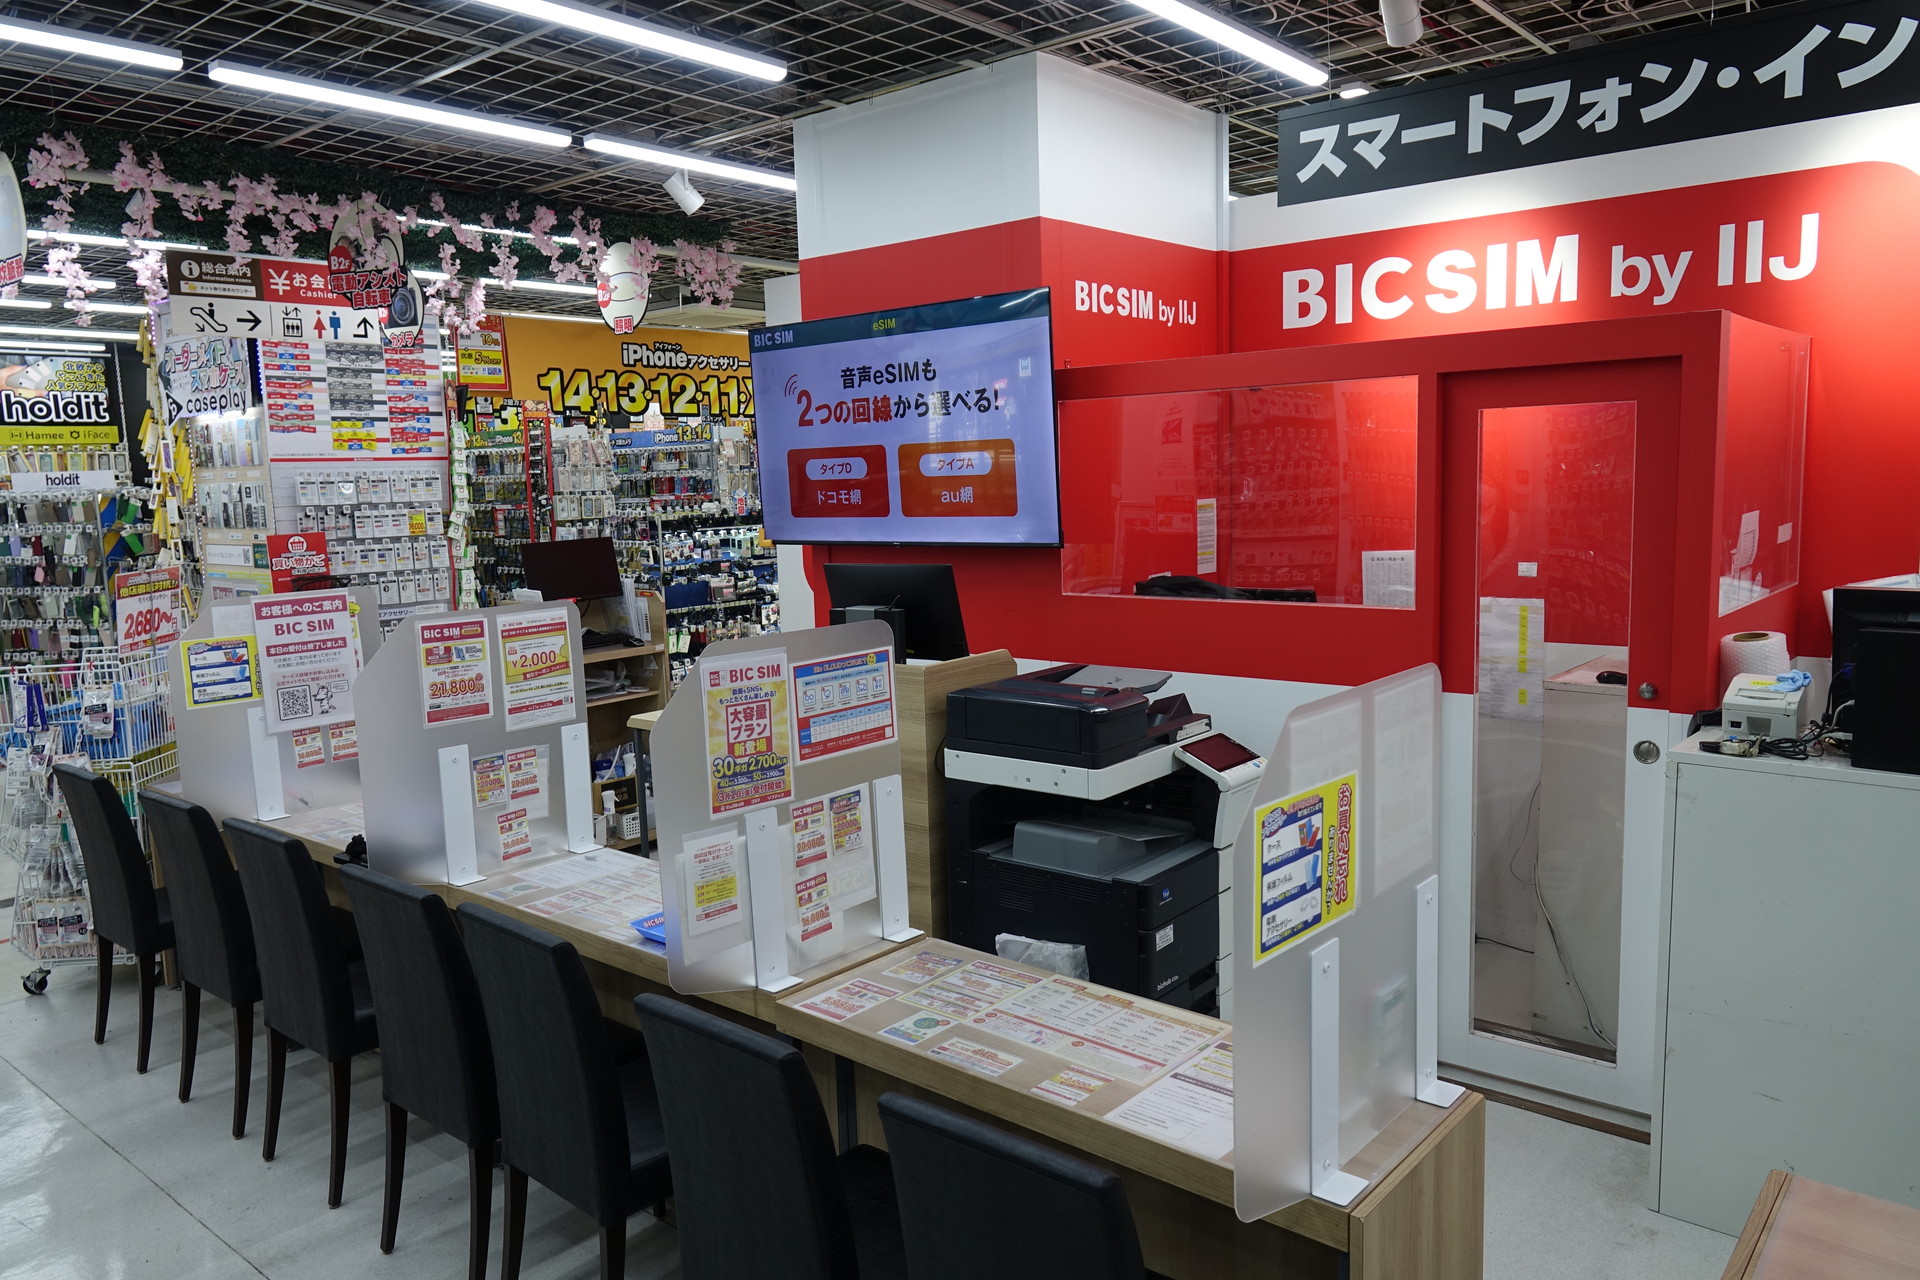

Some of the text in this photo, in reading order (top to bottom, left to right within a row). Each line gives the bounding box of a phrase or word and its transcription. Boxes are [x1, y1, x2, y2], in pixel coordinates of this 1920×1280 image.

[1297, 16, 1919, 183] スマートフォン・イン
[201, 260, 252, 277] 総合案内
[331, 256, 350, 271] B2F
[1283, 212, 1820, 329] BIC SIM by IIJ
[330, 268, 407, 293] 電動アシスト
[300, 289, 338, 300] Cashier
[352, 289, 391, 308] 自転車
[1075, 279, 1197, 327] BIC SIM by IIJ
[615, 318, 633, 333] 照明
[872, 318, 897, 331] eSIM
[390, 332, 414, 348] カメラ
[754, 330, 793, 347] BIC SIM
[622, 343, 750, 370] iPhone アクセサリー
[840, 358, 937, 390] 音声eSIMも
[2, 390, 110, 423] holdit
[187, 387, 246, 416] caseplay
[26, 431, 110, 440] Hamee iFace
[654, 432, 679, 444] iPhone
[819, 462, 853, 476] タイプD
[936, 458, 975, 472] タイプA
[45, 474, 80, 486] holdit
[816, 490, 862, 505] ドコモ網
[940, 487, 974, 503] au網
[272, 553, 326, 571] 買い物かご
[261, 599, 342, 617] お客様へのご案内
[274, 618, 335, 637] BIC SIM
[423, 626, 461, 639] BIC SIM
[270, 639, 345, 655] 本日の受付は終了しました
[729, 664, 781, 683] BIC SIM
[429, 678, 477, 700] 21,800
[719, 691, 777, 705] もっとたくさん楽しめる!
[729, 704, 768, 725] 大容量
[731, 722, 768, 741] プラン
[733, 738, 767, 757] 新登場
[1266, 840, 1282, 854] ケース
[1334, 782, 1353, 906] お買い忘れ
[1266, 873, 1293, 892] 保護フィルム
[1266, 918, 1293, 937] アクセサリー
[1157, 977, 1172, 991] bizhub
